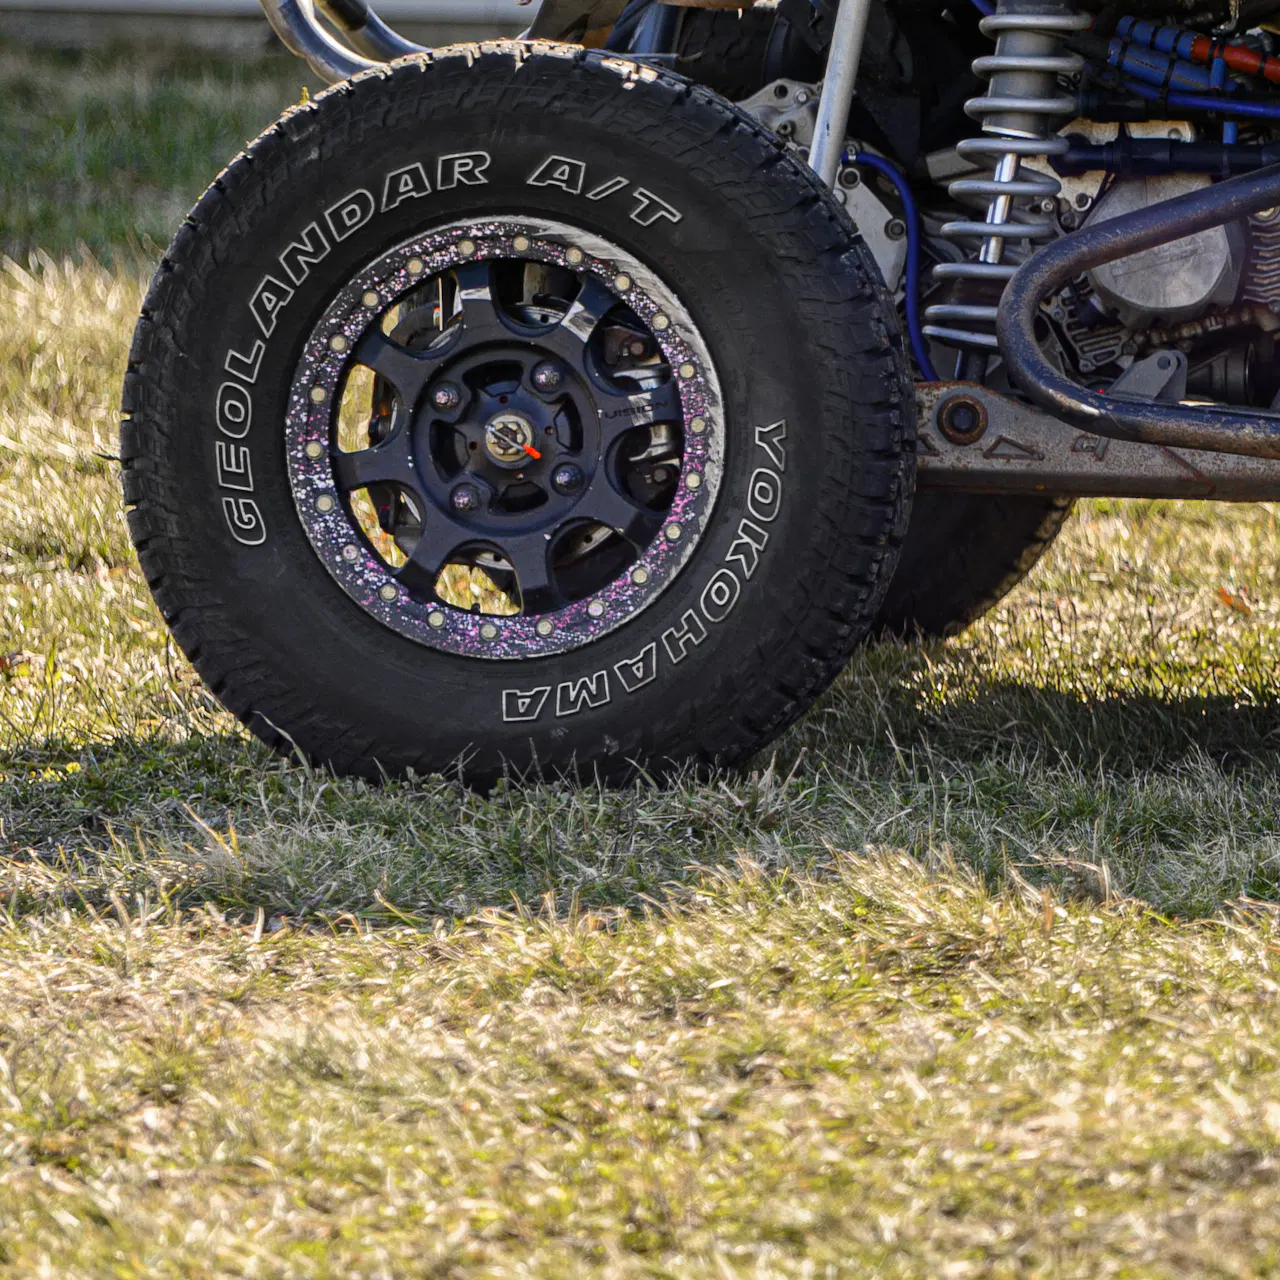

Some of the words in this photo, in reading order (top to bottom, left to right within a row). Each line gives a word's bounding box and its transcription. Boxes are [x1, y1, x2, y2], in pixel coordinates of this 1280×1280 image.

[215, 150, 491, 547] GEOLANDAR
[526, 154, 683, 230] A/T
[502, 419, 788, 722] YOKOHAMA
